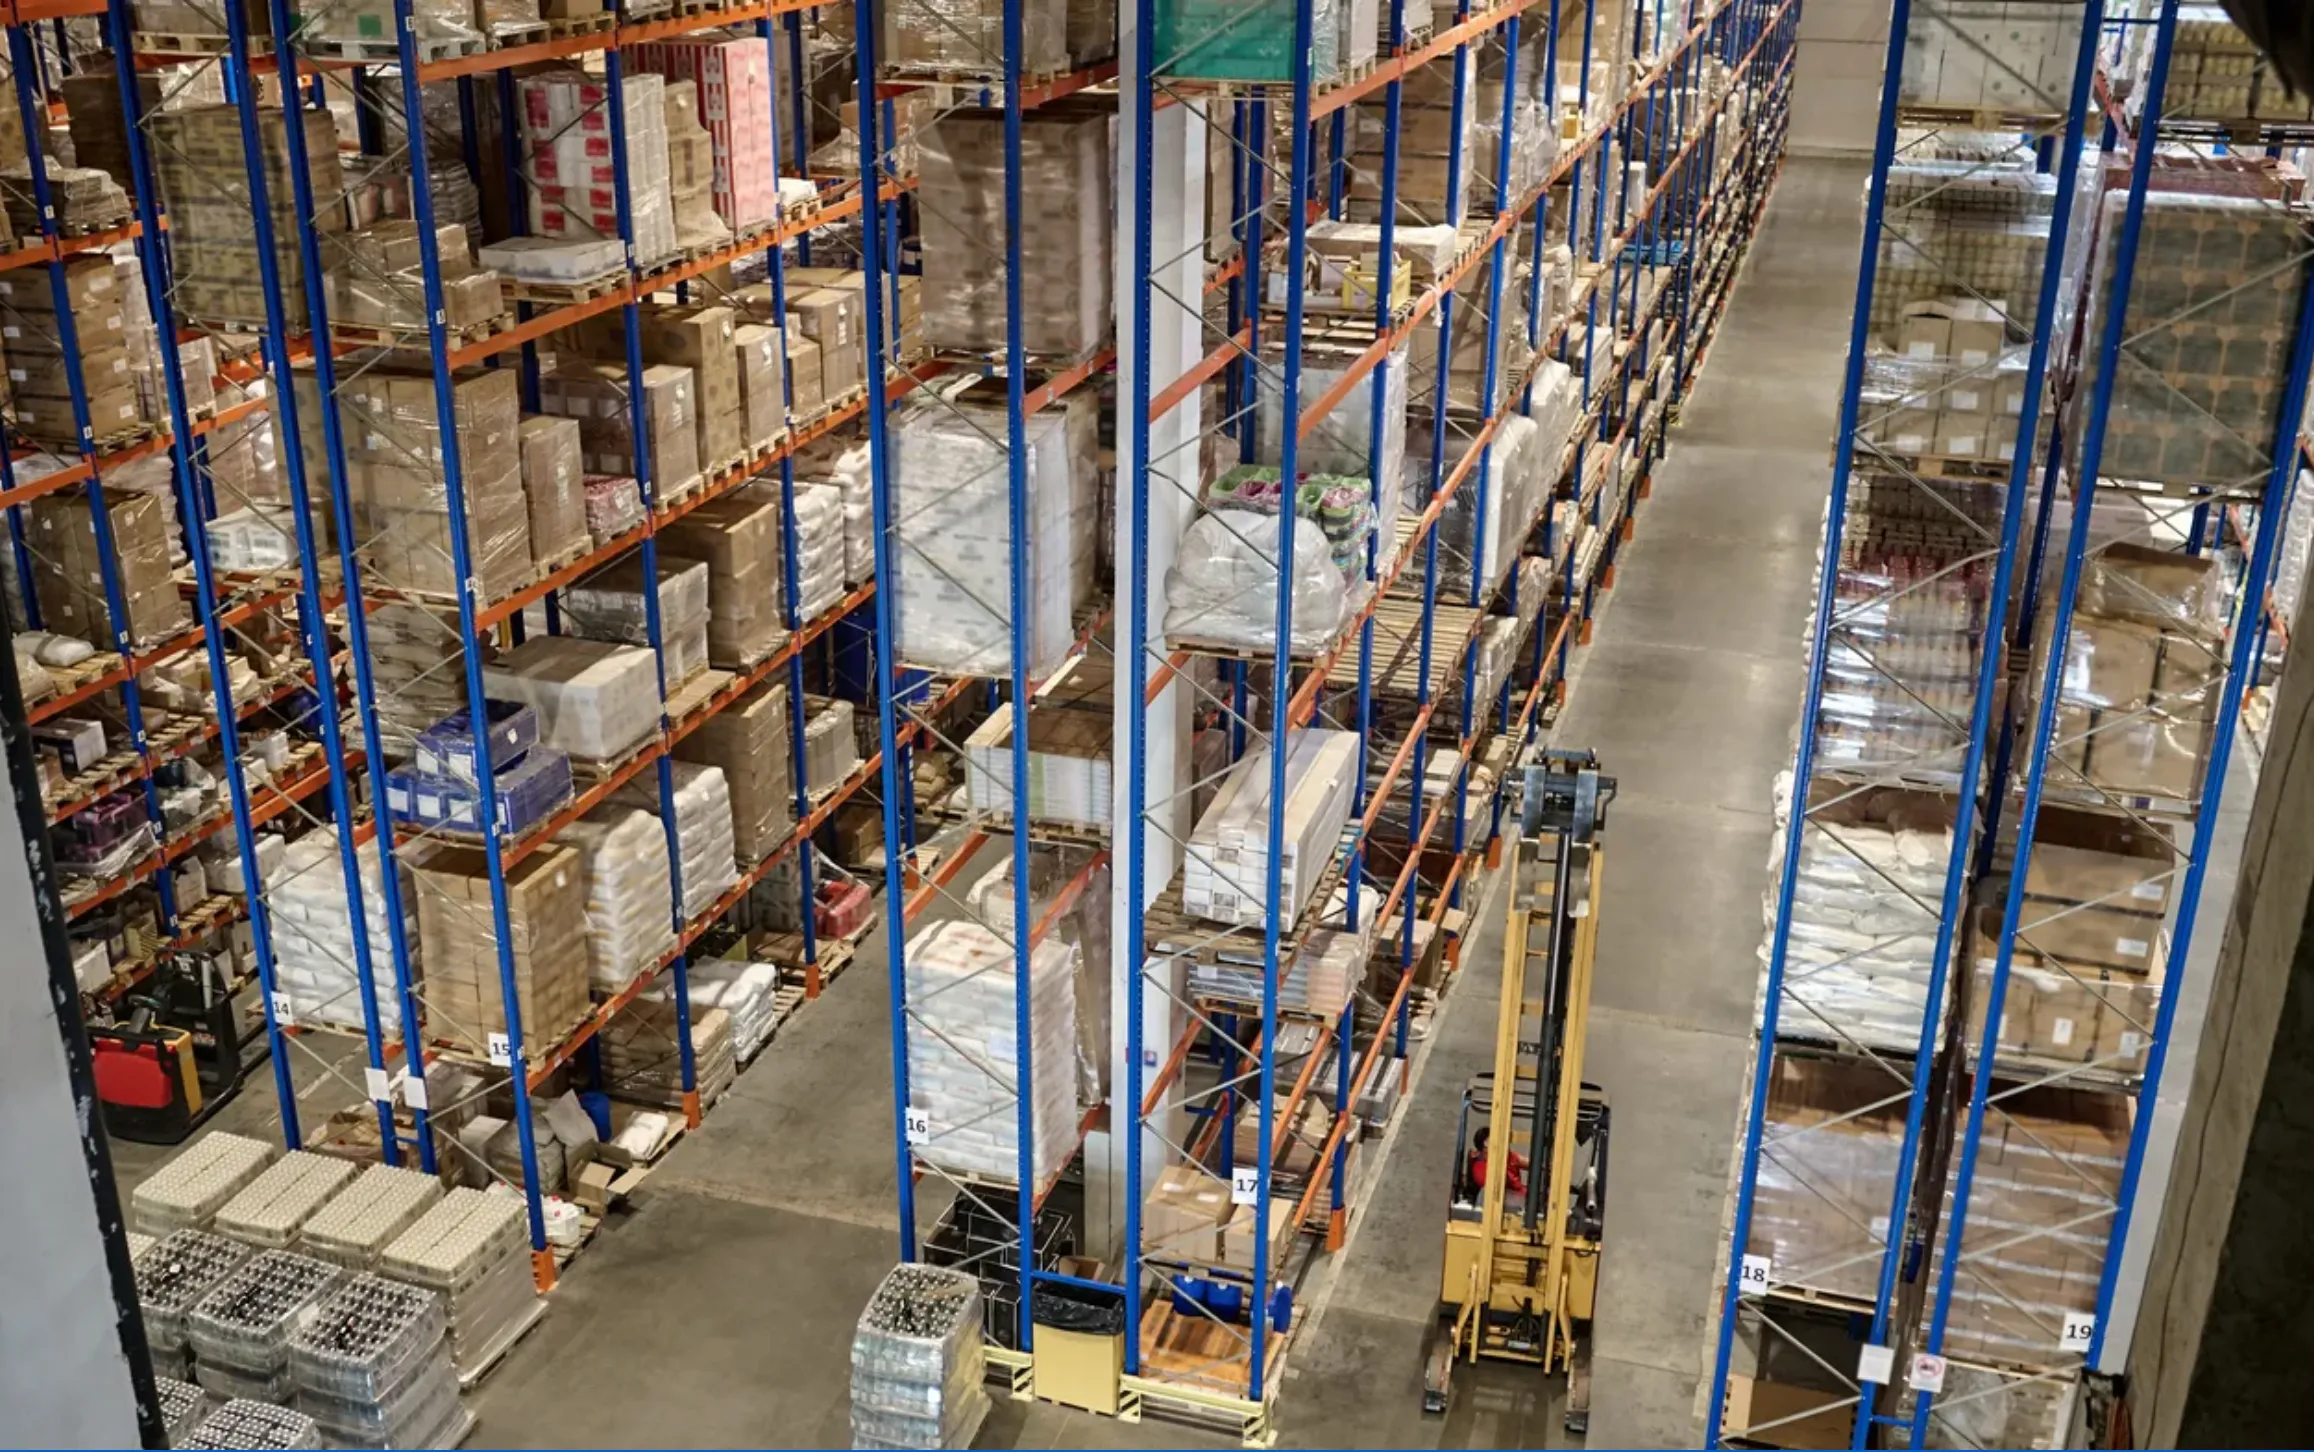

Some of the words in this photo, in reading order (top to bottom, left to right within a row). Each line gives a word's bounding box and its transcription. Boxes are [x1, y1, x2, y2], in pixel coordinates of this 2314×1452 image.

[274, 1001, 289, 1016] 14
[493, 1042, 511, 1056] 15
[908, 1118, 926, 1133] 16
[1236, 1178, 1258, 1193] 17
[1743, 1264, 1765, 1282] 18
[2067, 1324, 2092, 1339] 19
